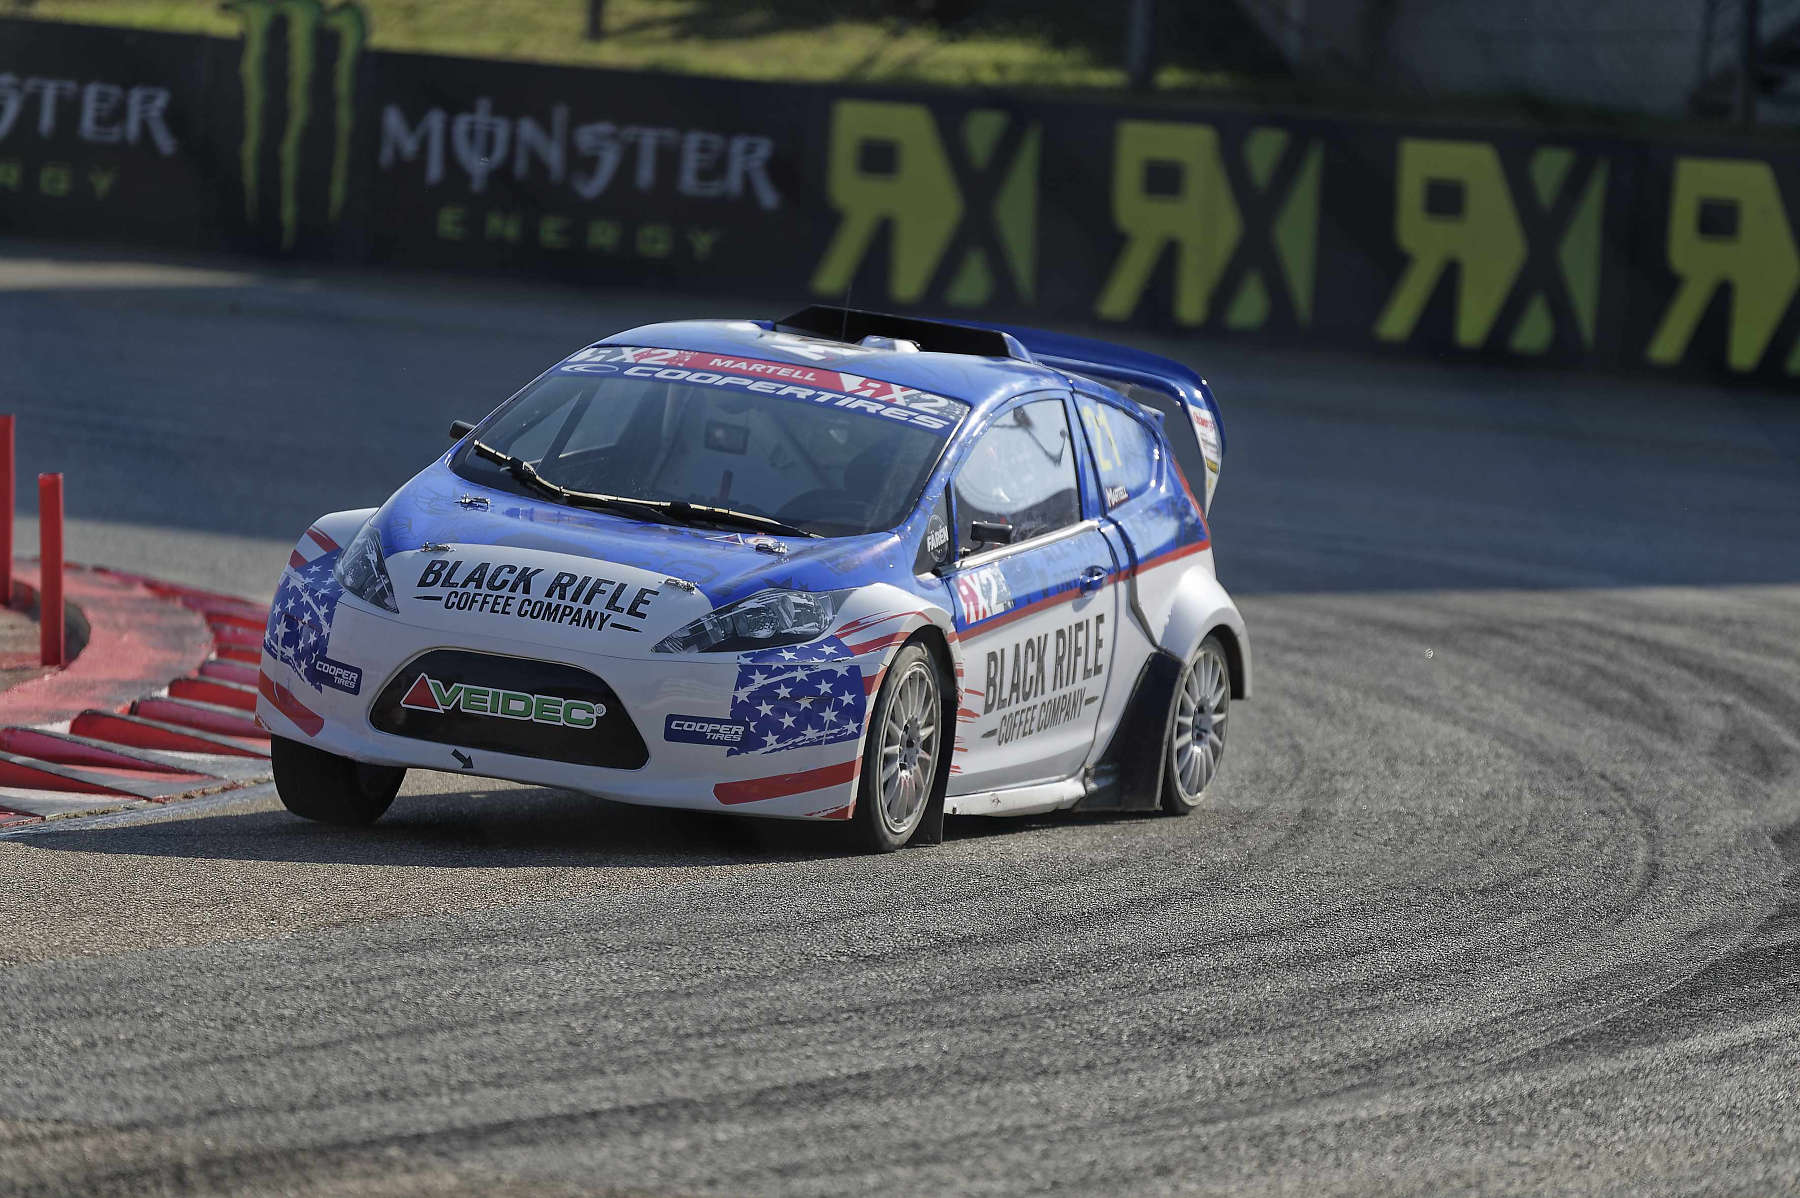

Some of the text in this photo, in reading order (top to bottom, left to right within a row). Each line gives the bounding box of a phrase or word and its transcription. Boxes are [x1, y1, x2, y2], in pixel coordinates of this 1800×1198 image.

[376, 95, 780, 210] MONSTER
[437, 203, 721, 261] ENERGY
[1648, 157, 1800, 375] R
[709, 356, 818, 382] MARTELL
[416, 559, 660, 620] BLACK RIFLE
[444, 590, 612, 632] COFFEE COMPANY
[315, 661, 359, 682] COOPER
[333, 676, 357, 689] TIRES
[983, 613, 1106, 715] BLACK RIFLE
[670, 720, 745, 735] COOPER
[705, 732, 743, 742] TIRES
[998, 687, 1087, 746] COFFEE COMPANY
